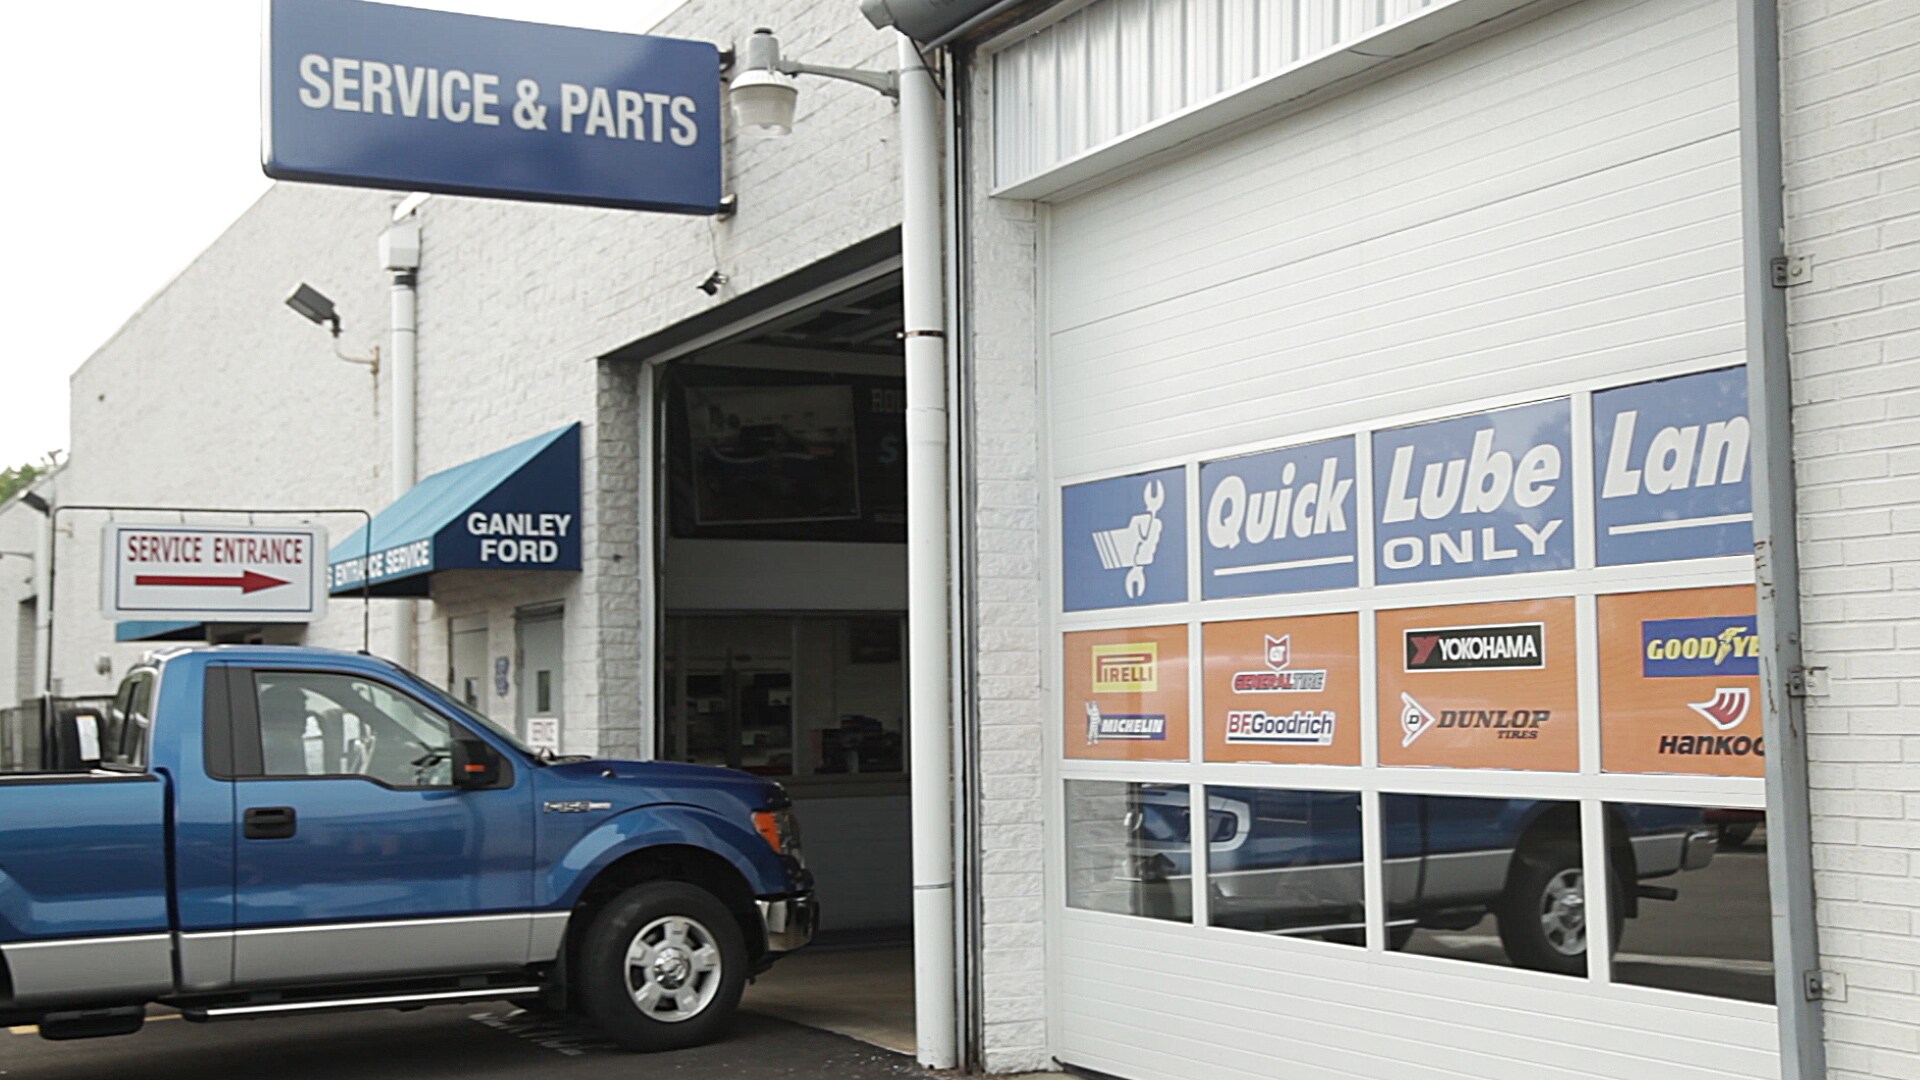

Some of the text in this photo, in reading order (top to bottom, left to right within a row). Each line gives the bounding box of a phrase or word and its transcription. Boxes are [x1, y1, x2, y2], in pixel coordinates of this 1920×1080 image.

[299, 53, 697, 146] SERVICE & PARTS
[1206, 410, 1751, 549] Quick Lube Lan
[467, 512, 571, 536] GANLEY
[127, 535, 303, 564] SERVICE ENTRANCE
[481, 539, 558, 563] FORD
[1382, 519, 1564, 570] ONLY
[335, 552, 384, 586] ENTRACE
[386, 540, 430, 575] SERVICE
[1439, 635, 1538, 660] YOKOHAMA
[1096, 653, 1153, 683] PIRELLI
[1101, 718, 1164, 733] MICHELIN
[1437, 710, 1551, 728] DUNLOP
[1498, 730, 1539, 740] TIRES
